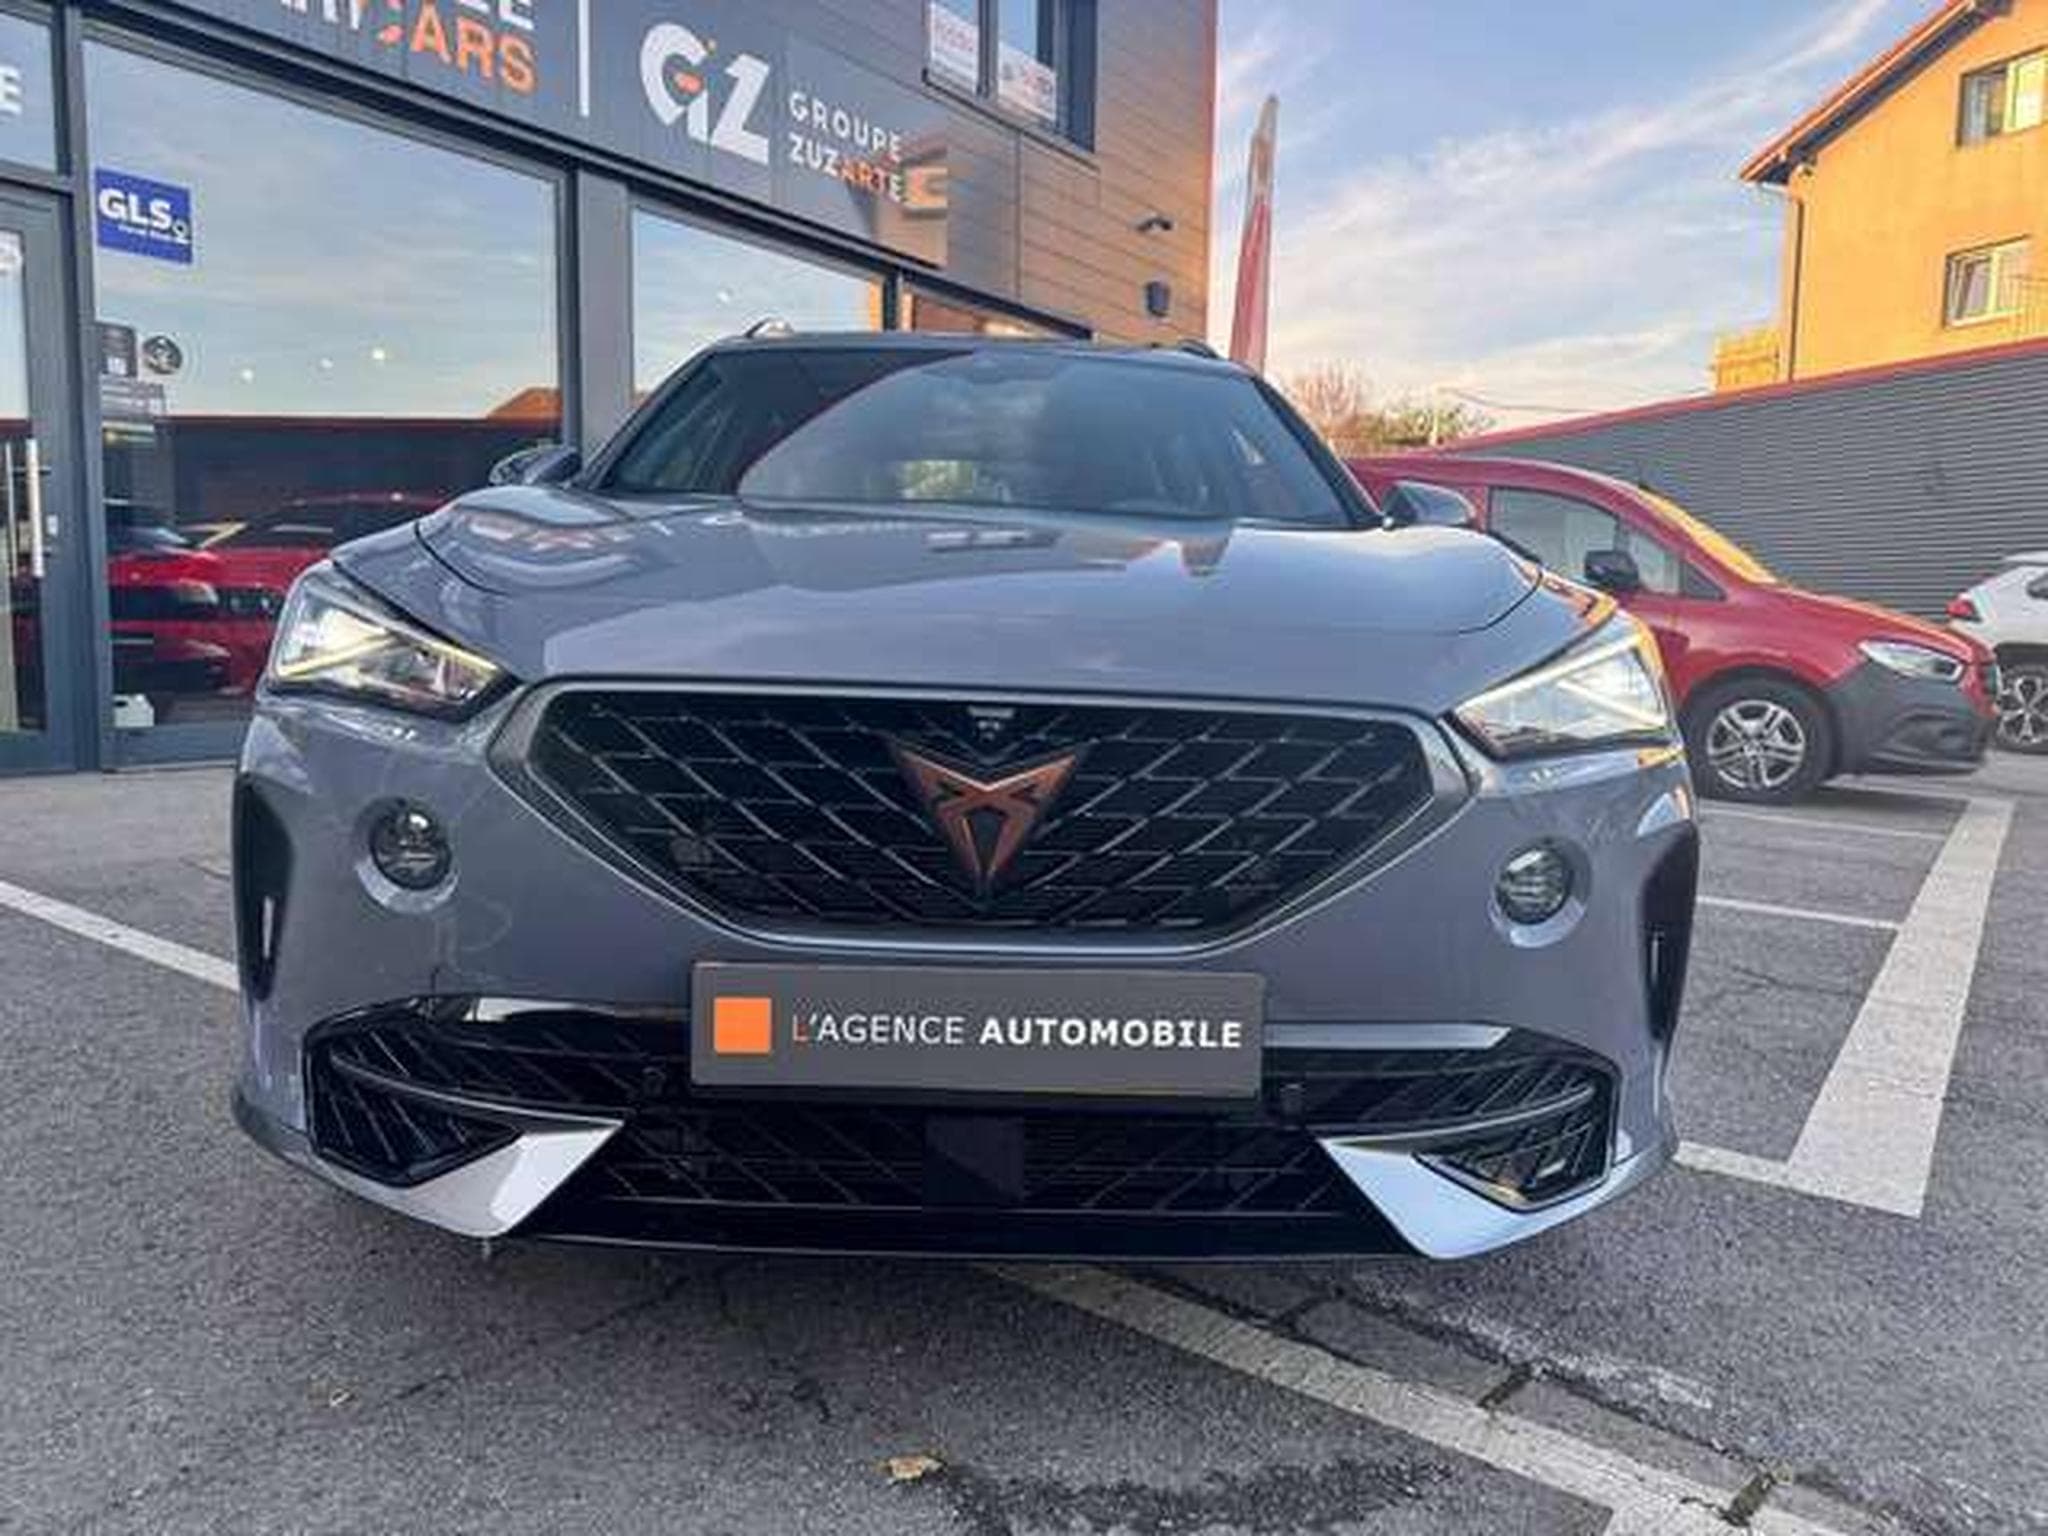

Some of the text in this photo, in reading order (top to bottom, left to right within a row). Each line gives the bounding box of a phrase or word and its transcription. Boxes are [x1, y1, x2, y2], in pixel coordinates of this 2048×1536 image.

[787, 91, 902, 163] GROUPE
[787, 132, 903, 203] ZUZARTE
[98, 187, 174, 231] GLS
[792, 1012, 1243, 1049] L'AGENCE AUTOMOBILE
